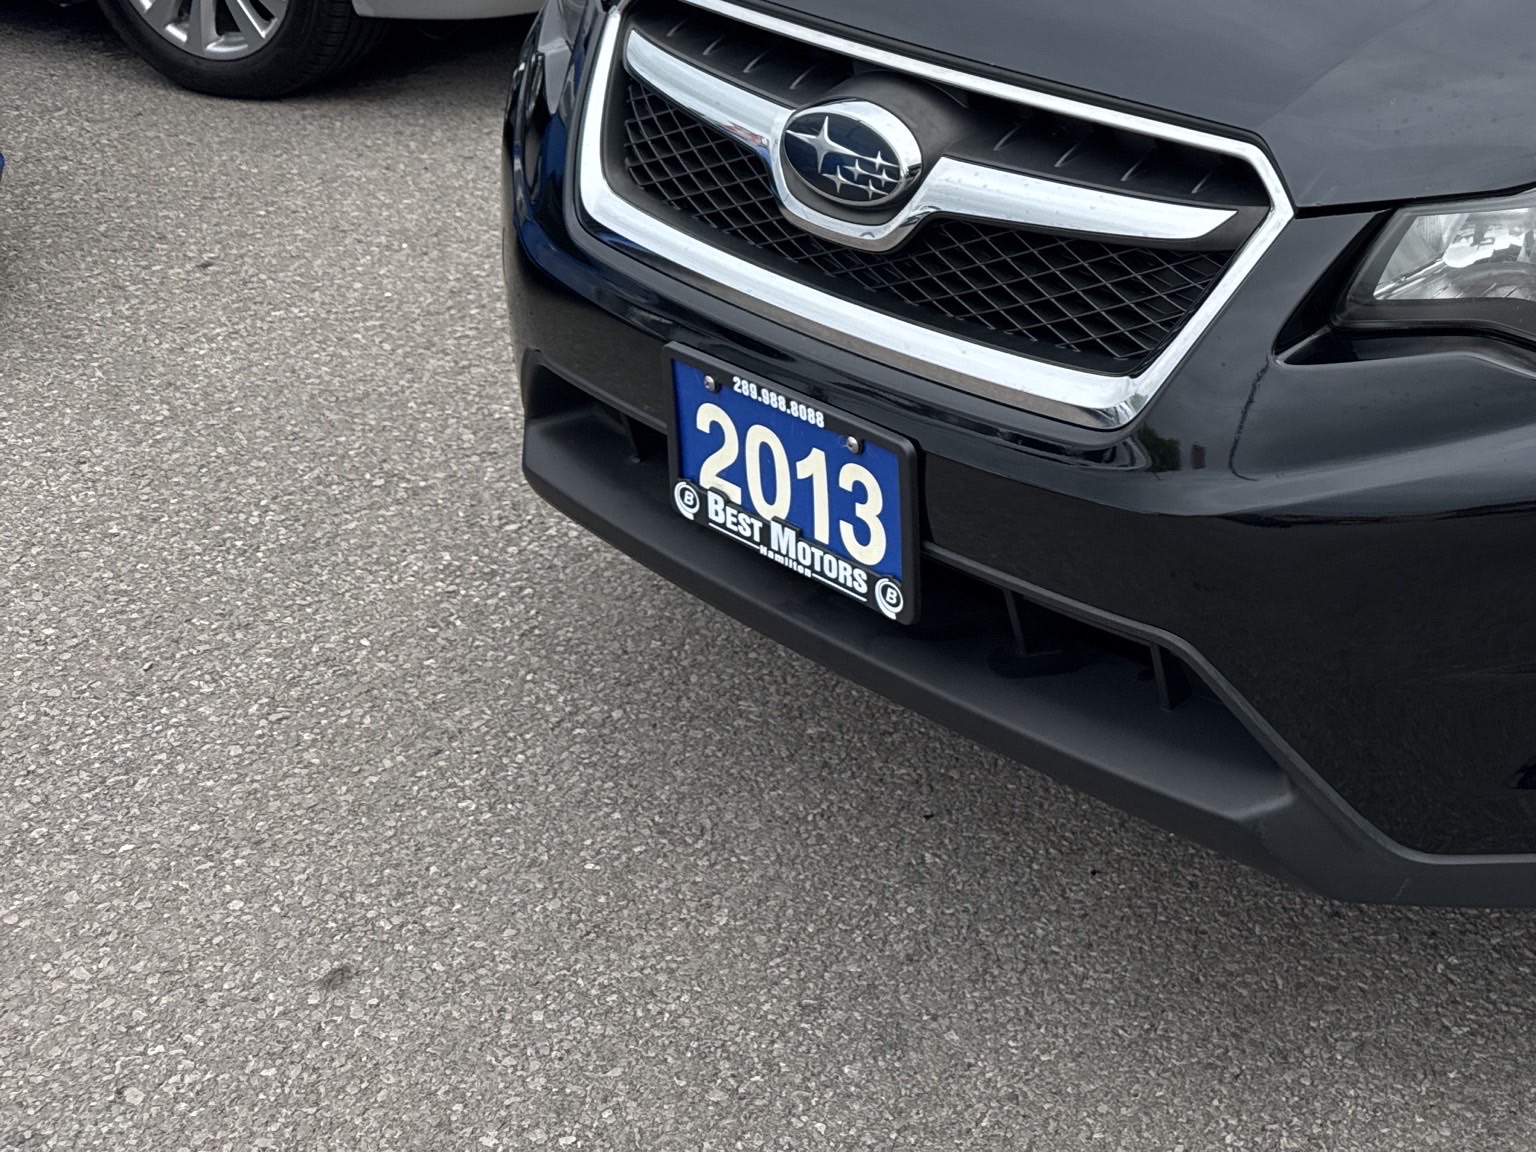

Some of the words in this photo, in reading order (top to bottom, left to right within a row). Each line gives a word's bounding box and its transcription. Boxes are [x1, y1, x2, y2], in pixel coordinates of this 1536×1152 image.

[732, 375, 825, 428] 289.988.8088
[695, 402, 887, 566] 2013
[707, 490, 763, 543] BEST
[770, 520, 868, 594] MOTORS
[759, 544, 812, 578] Hamilton
